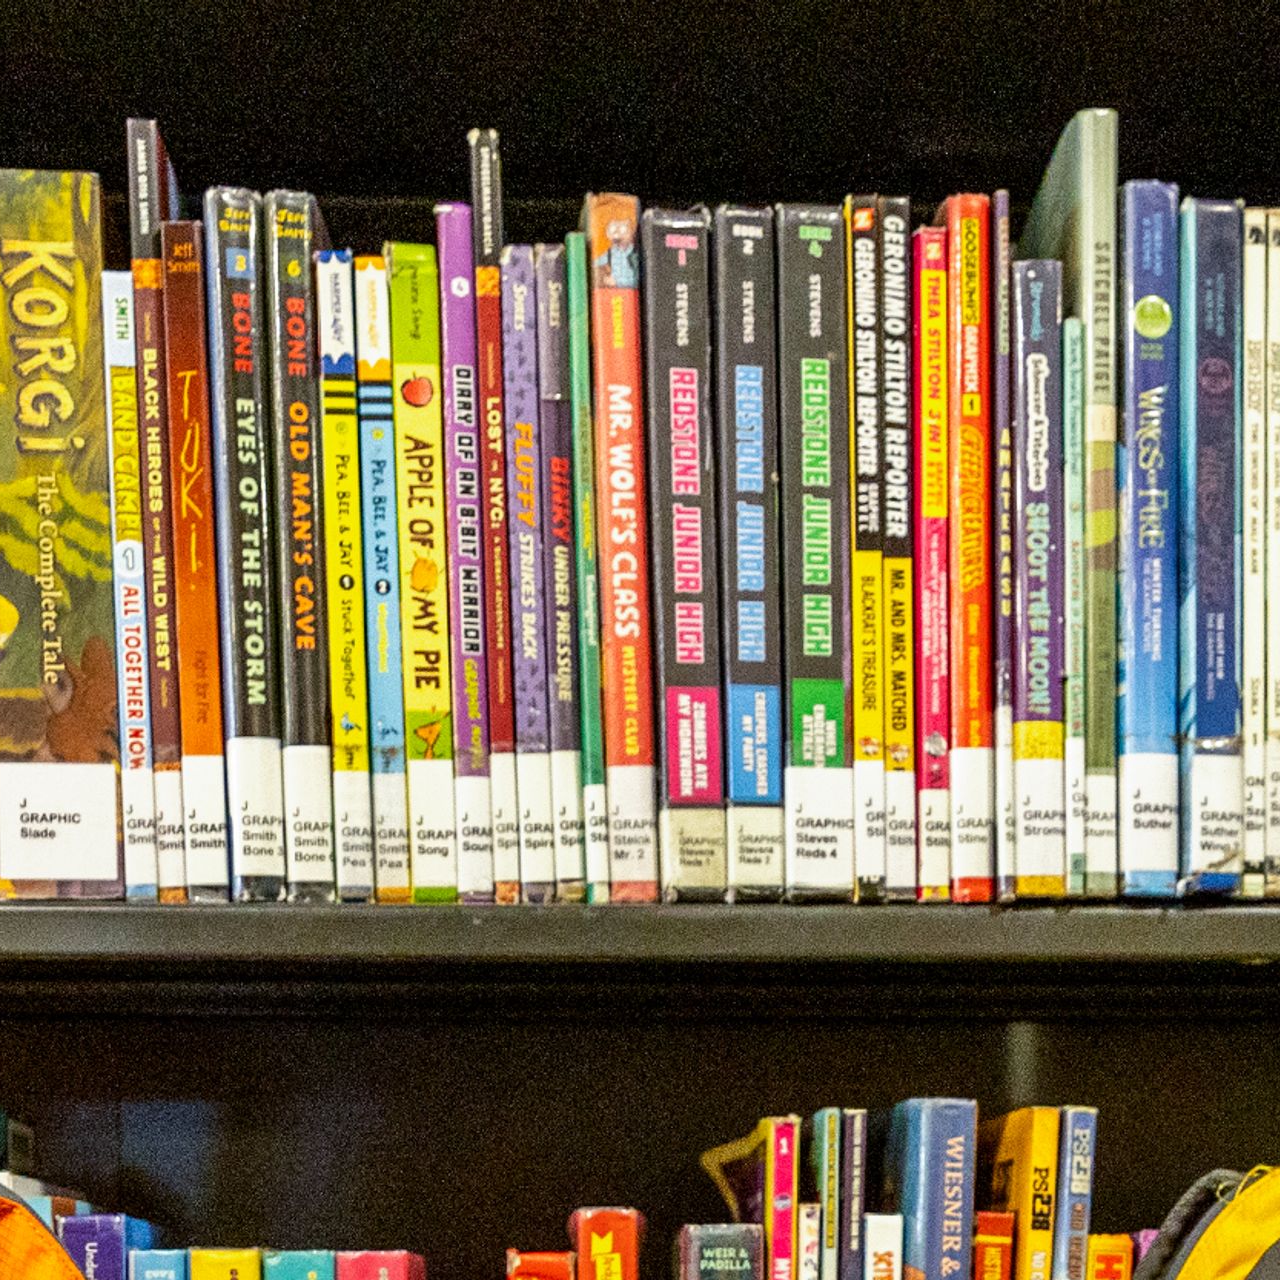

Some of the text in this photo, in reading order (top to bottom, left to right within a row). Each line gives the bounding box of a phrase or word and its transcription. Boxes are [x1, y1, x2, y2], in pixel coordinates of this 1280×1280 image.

[286, 297, 315, 650] BONE OLD MAN'S CAVE
[883, 215, 908, 537] GERONIMO STILTON REPORTER
[1136, 386, 1165, 469] WINGS
[36, 472, 64, 685] The Complete Tale
[123, 586, 140, 615] ALL
[233, 291, 266, 704] BONE EYES OF THE STORM
[405, 435, 440, 689] APPLE OF MY PIE
[516, 422, 537, 659] FLUFFY STRIKES BACK
[609, 385, 638, 637] MR. WOLF'S CLASS
[735, 365, 765, 662] REDSTONE JUNIOR HIGH
[1139, 489, 1169, 549] FIRE
[125, 626, 142, 718] TOGETHER
[941, 1135, 964, 1251] WIESNER
[1033, 1167, 1050, 1230] PS238
